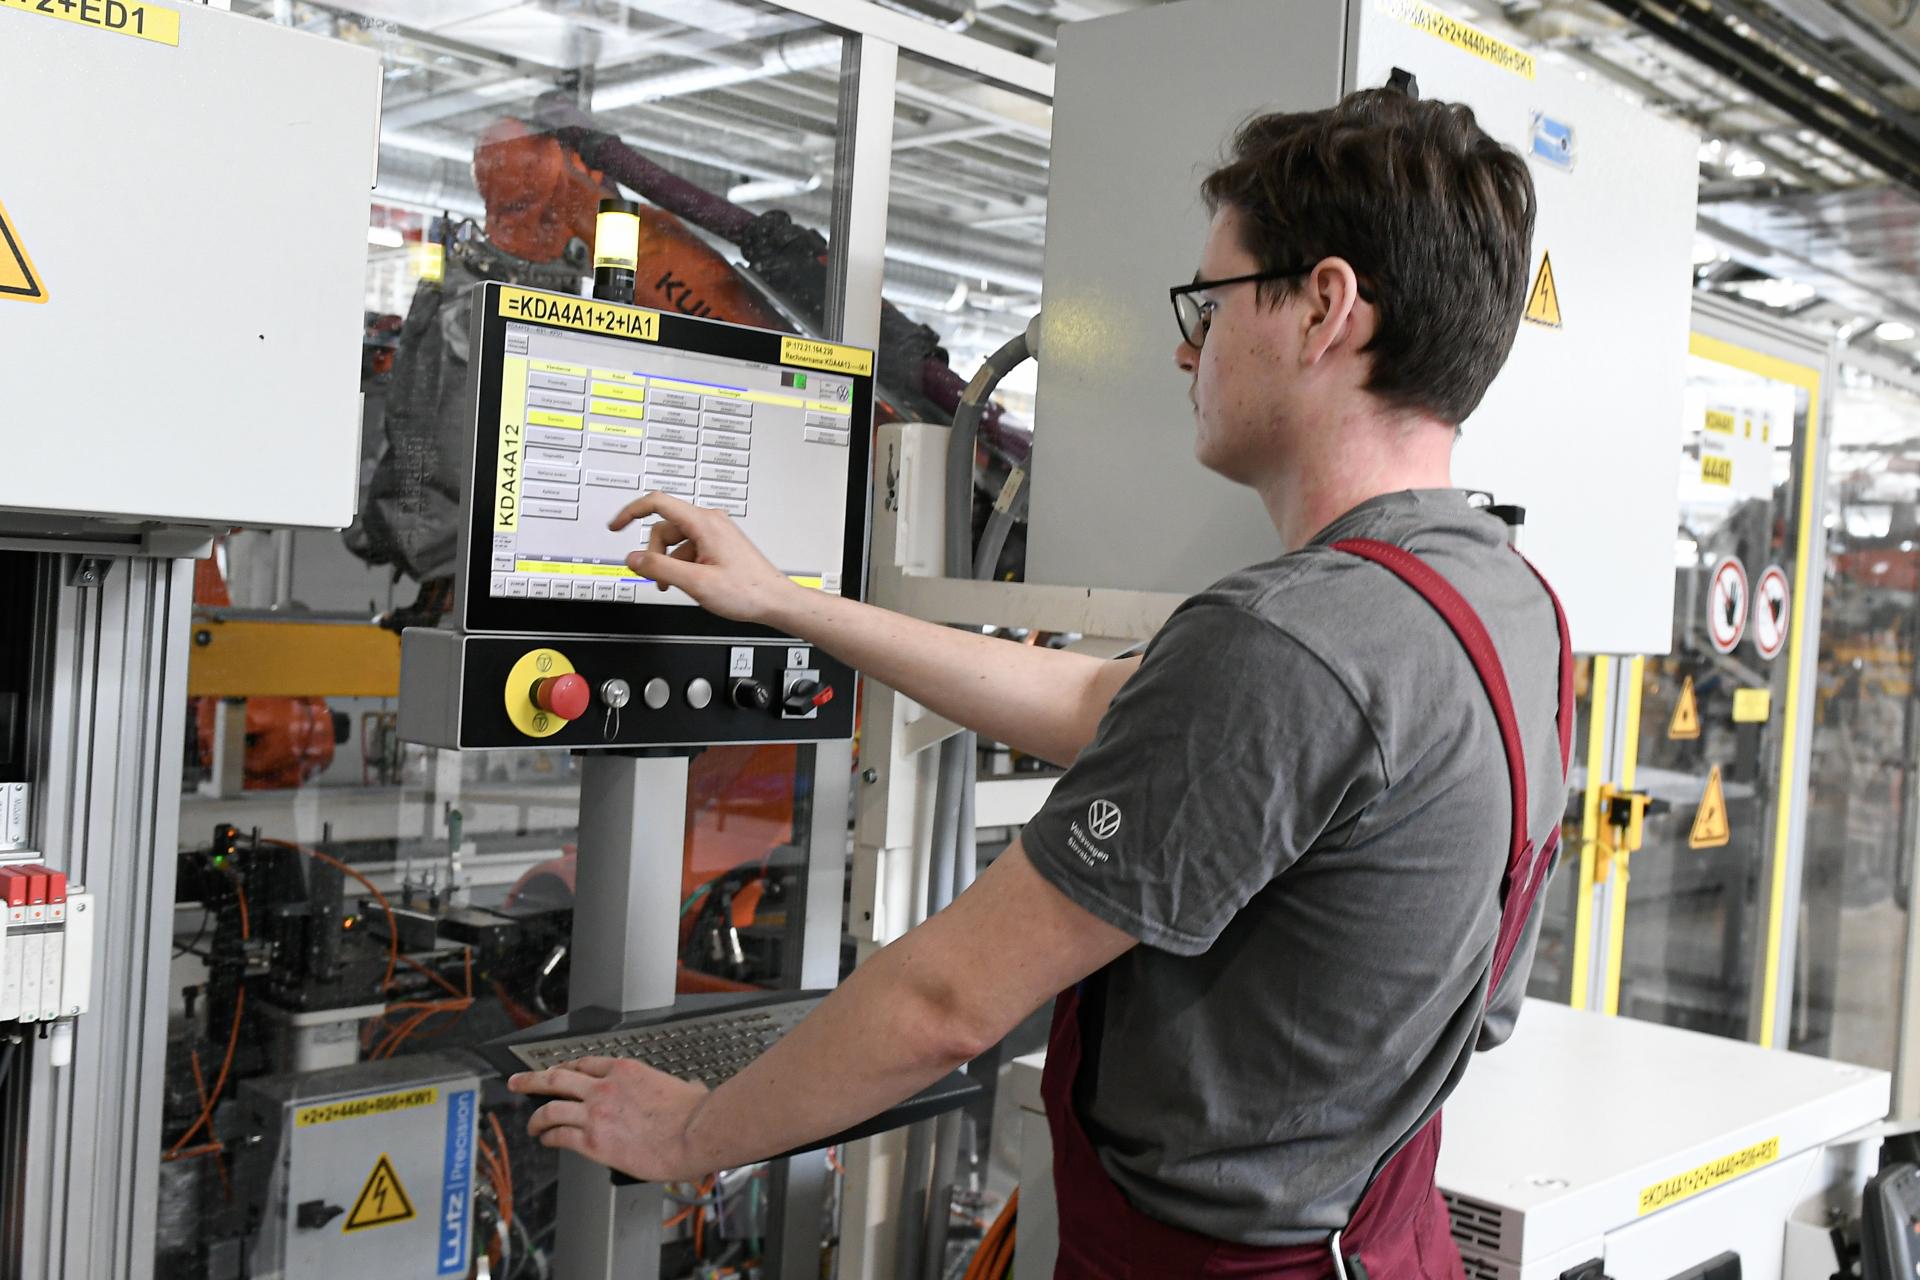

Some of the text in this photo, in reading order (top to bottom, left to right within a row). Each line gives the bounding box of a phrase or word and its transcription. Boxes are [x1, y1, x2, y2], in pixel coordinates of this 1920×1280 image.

[0, 0, 144, 34] 2+ED1
[509, 296, 652, 337] =KDA4A1+2+IA1
[656, 272, 722, 320] KU
[500, 424, 520, 526] KDA4A12
[1070, 821, 1109, 862] Volkswagen
[451, 1093, 469, 1182] Precision
